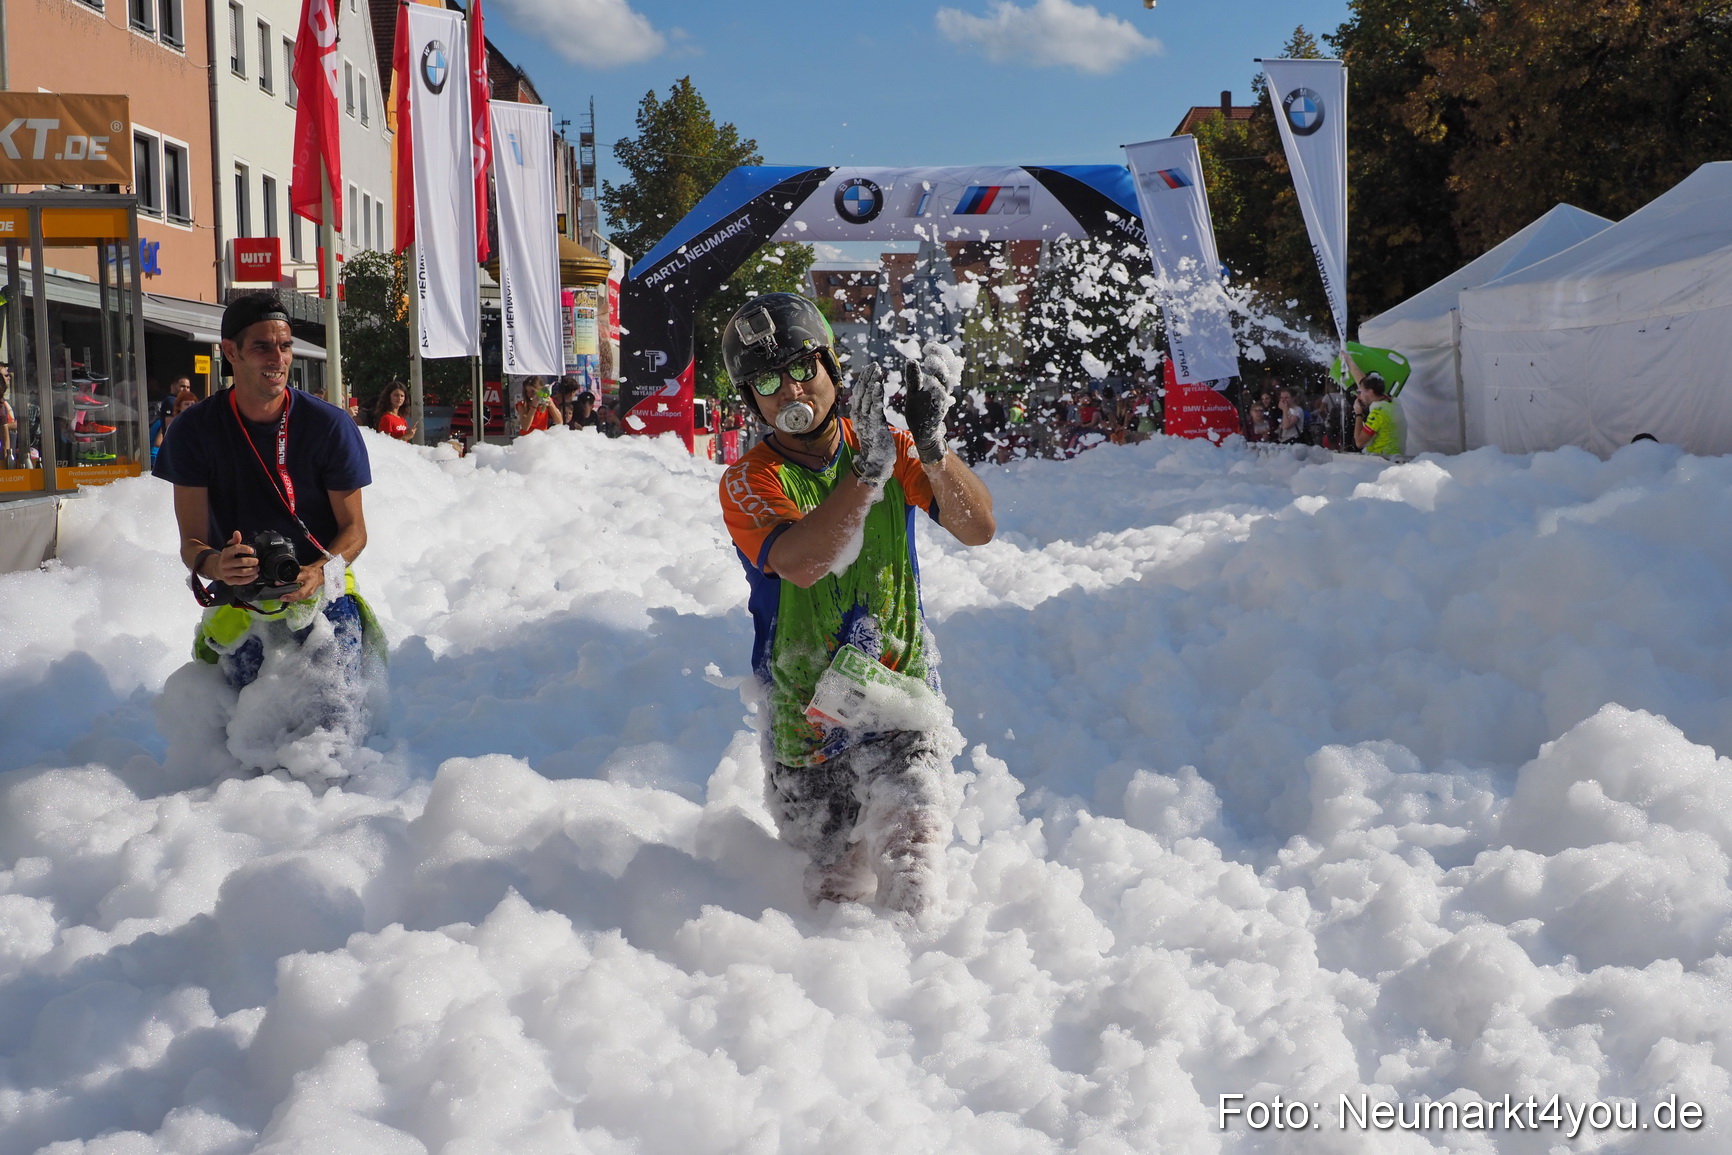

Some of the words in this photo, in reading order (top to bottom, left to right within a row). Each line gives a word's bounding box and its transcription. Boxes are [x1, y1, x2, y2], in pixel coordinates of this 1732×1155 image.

[839, 178, 879, 192] BMW
[645, 258, 686, 288] PARTL
[684, 214, 752, 263] NEUMARKT
[240, 252, 271, 264] WITT
[632, 409, 648, 417] BMW
